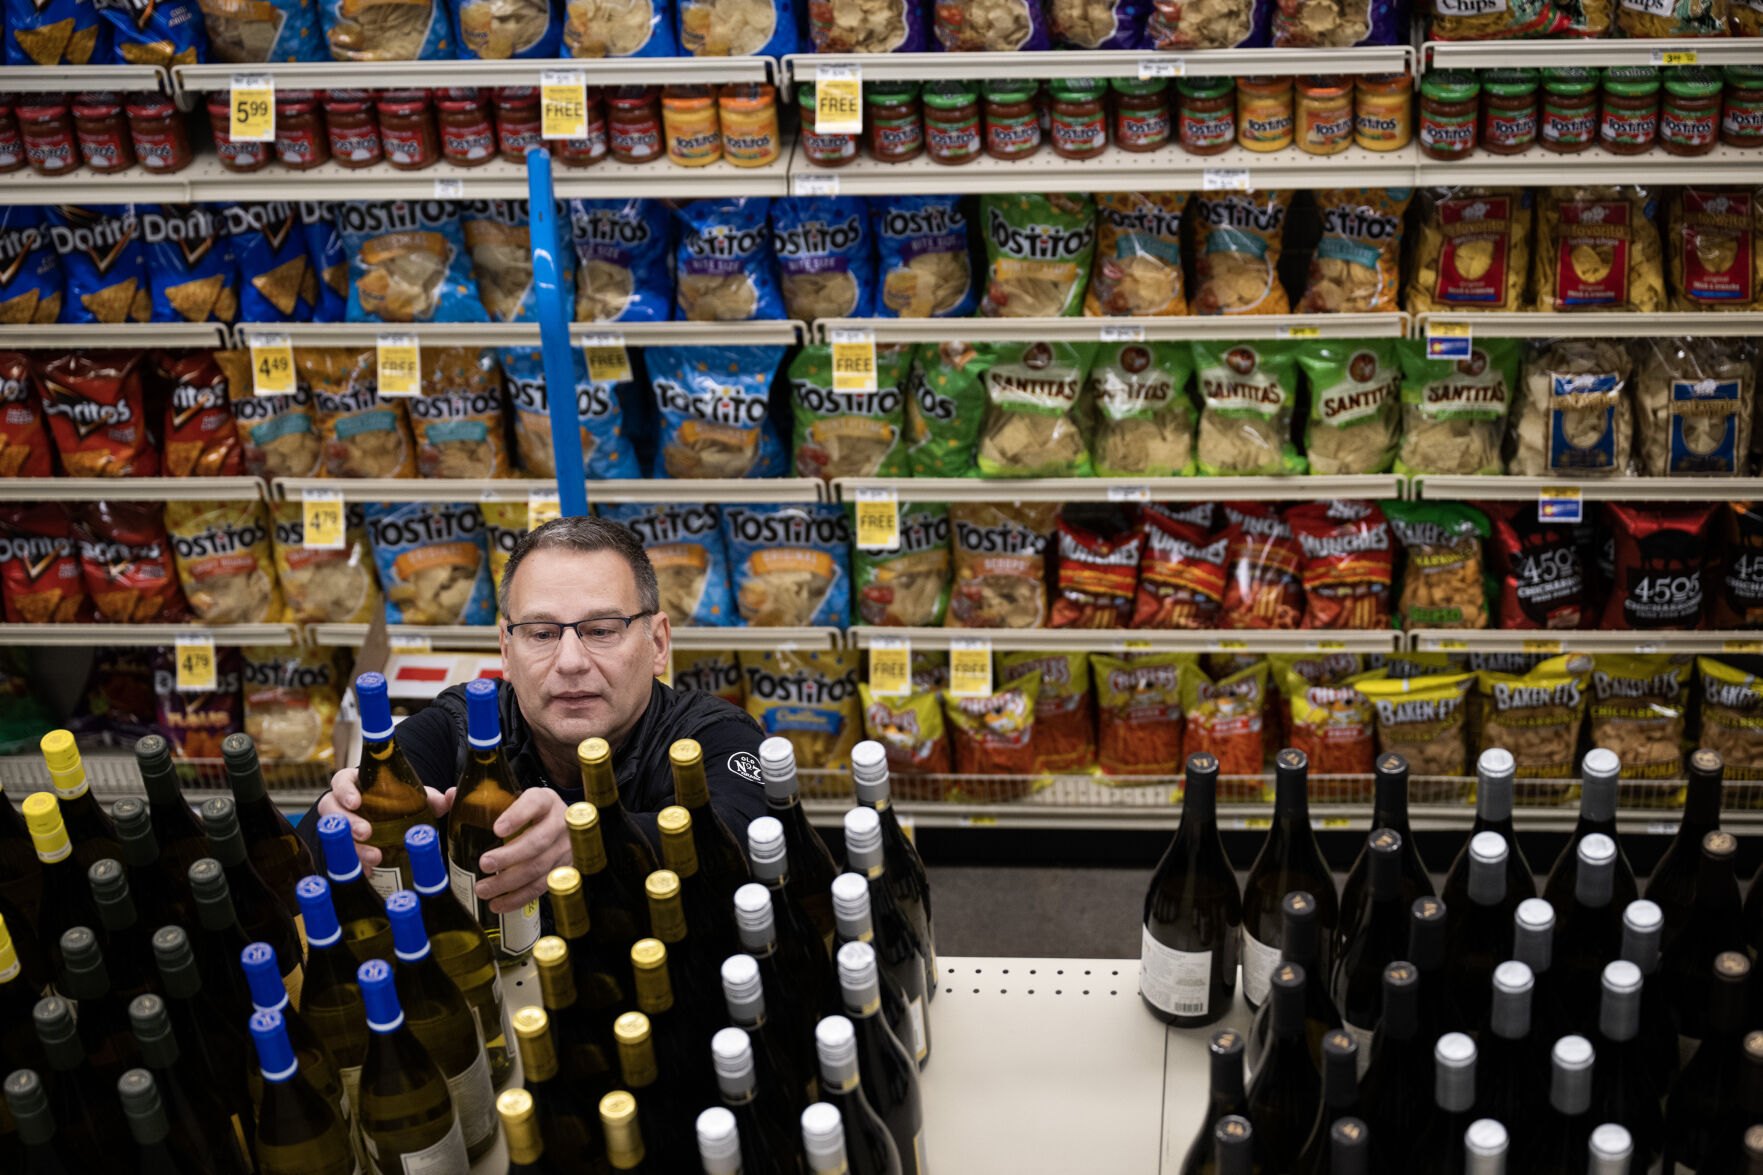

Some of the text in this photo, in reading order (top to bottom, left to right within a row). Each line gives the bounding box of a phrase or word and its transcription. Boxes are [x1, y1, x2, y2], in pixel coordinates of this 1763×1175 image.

[545, 102, 583, 118] FREE
[819, 97, 857, 113] FREE
[574, 212, 650, 243] stitos
[773, 216, 861, 255] ostitos
[590, 354, 626, 368] FREE
[836, 357, 874, 373] FREE
[656, 380, 768, 423] Tostito
[791, 379, 902, 414] Tostito
[1203, 380, 1282, 405] SANTITAS
[630, 504, 719, 543] stitos
[727, 509, 850, 544] Tostitos
[861, 514, 896, 529] FREE
[1299, 522, 1389, 558] MUNCHIES
[1522, 547, 1575, 584] 450
[1734, 554, 1763, 583] 45
[1634, 570, 1700, 604] 4505
[675, 658, 743, 694] stito
[873, 662, 907, 677] FREE
[954, 662, 989, 676] FREE
[746, 667, 857, 704] Tostitos
[741, 756, 755, 765] OLD
